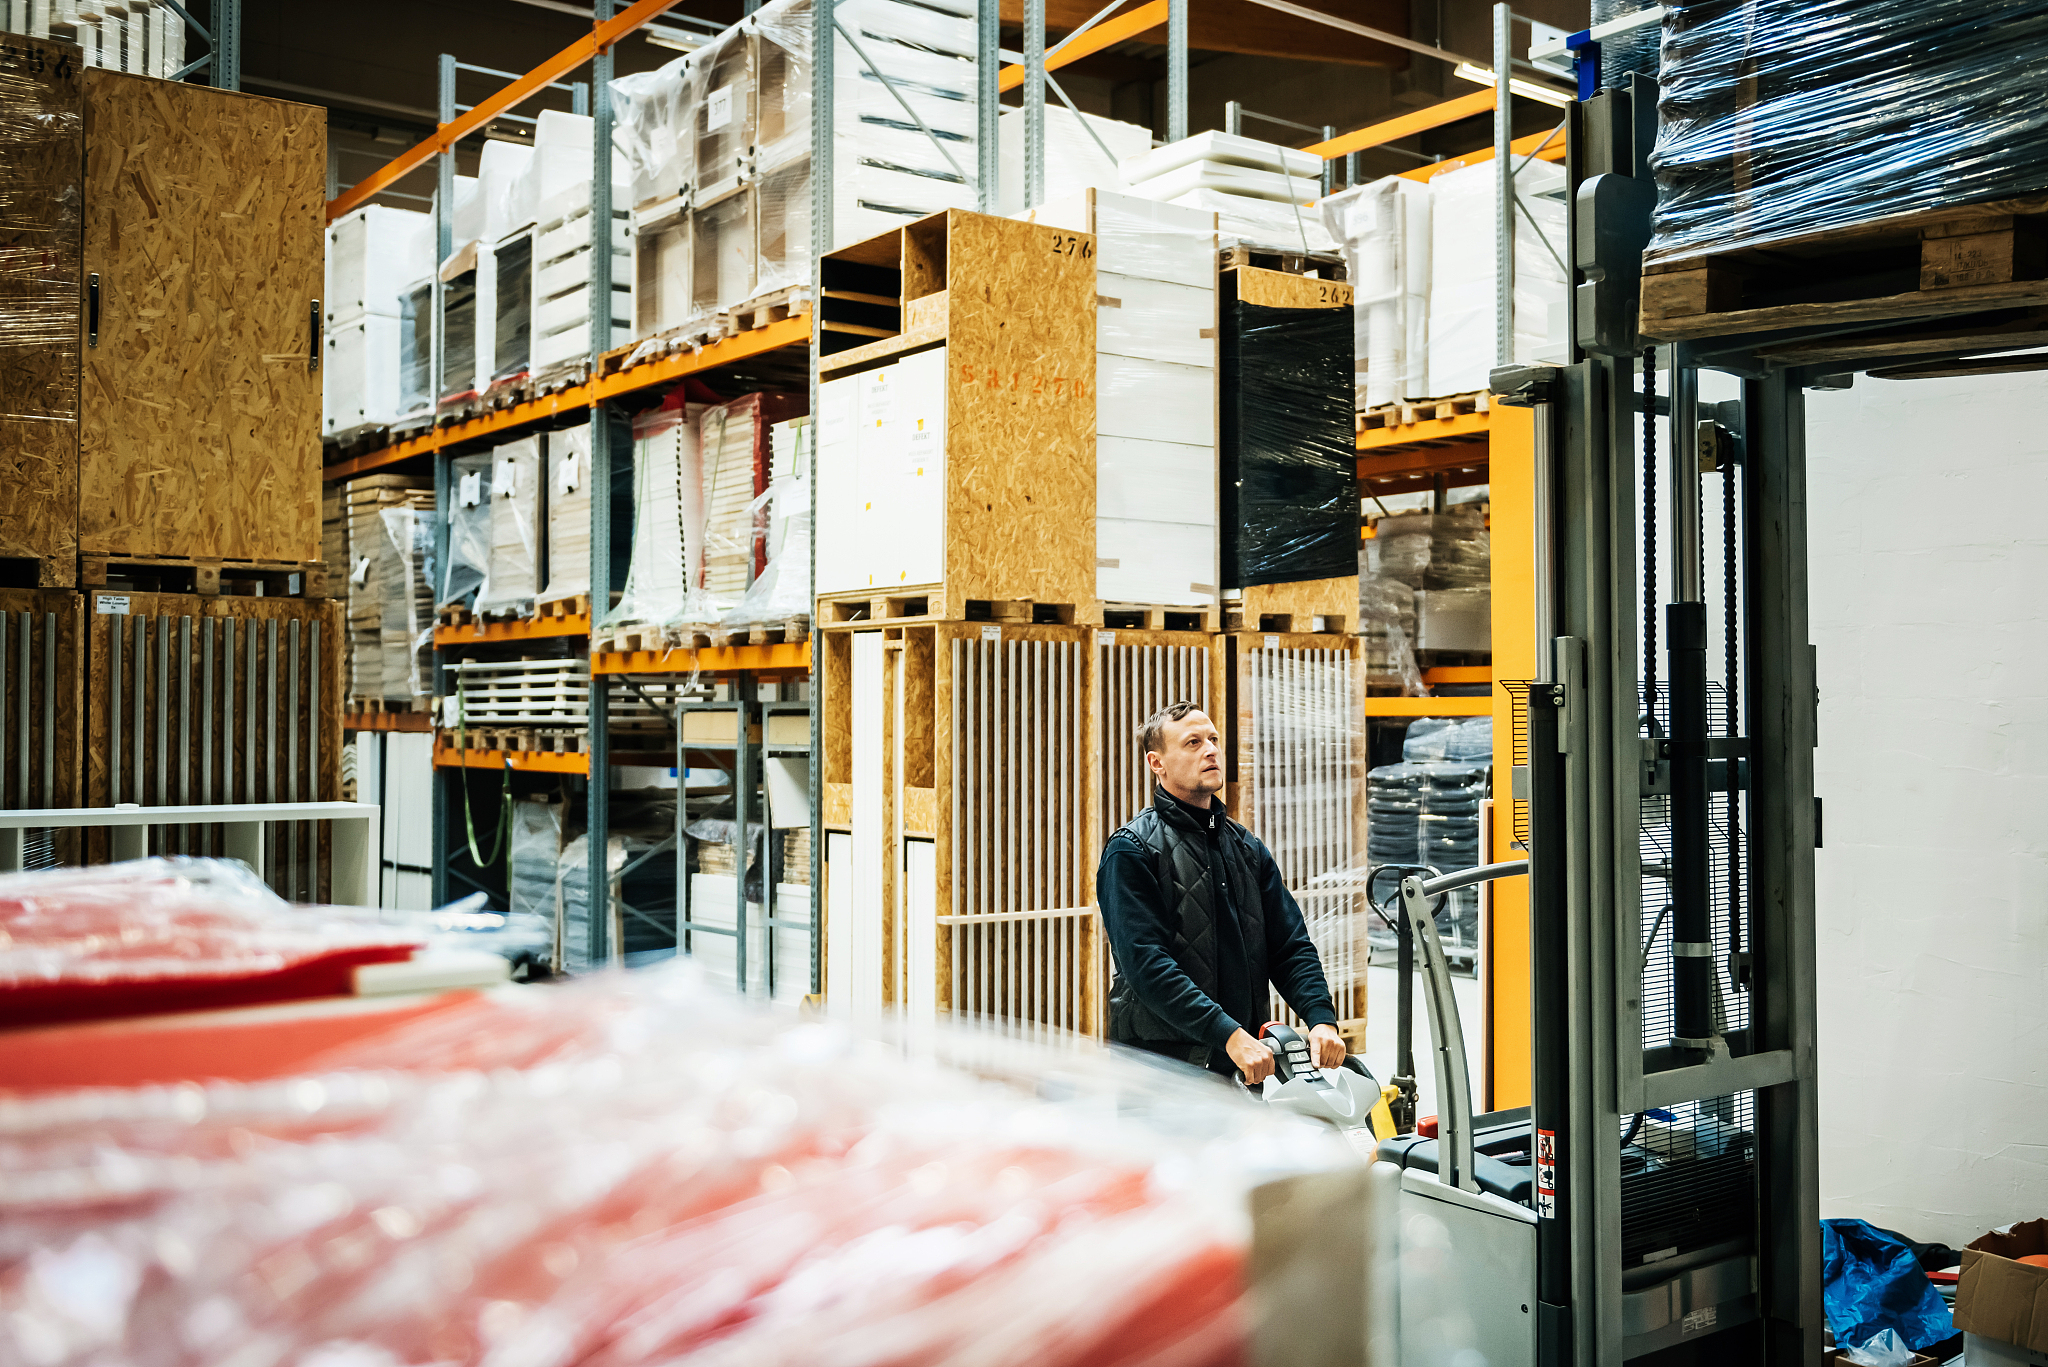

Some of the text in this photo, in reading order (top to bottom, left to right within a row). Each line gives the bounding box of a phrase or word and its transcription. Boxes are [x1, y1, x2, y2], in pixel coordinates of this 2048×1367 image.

[1052, 235, 1092, 259] 276
[1319, 286, 1350, 306] 262
[871, 384, 889, 394] DEFEKT
[911, 431, 931, 442] DEFEKT
